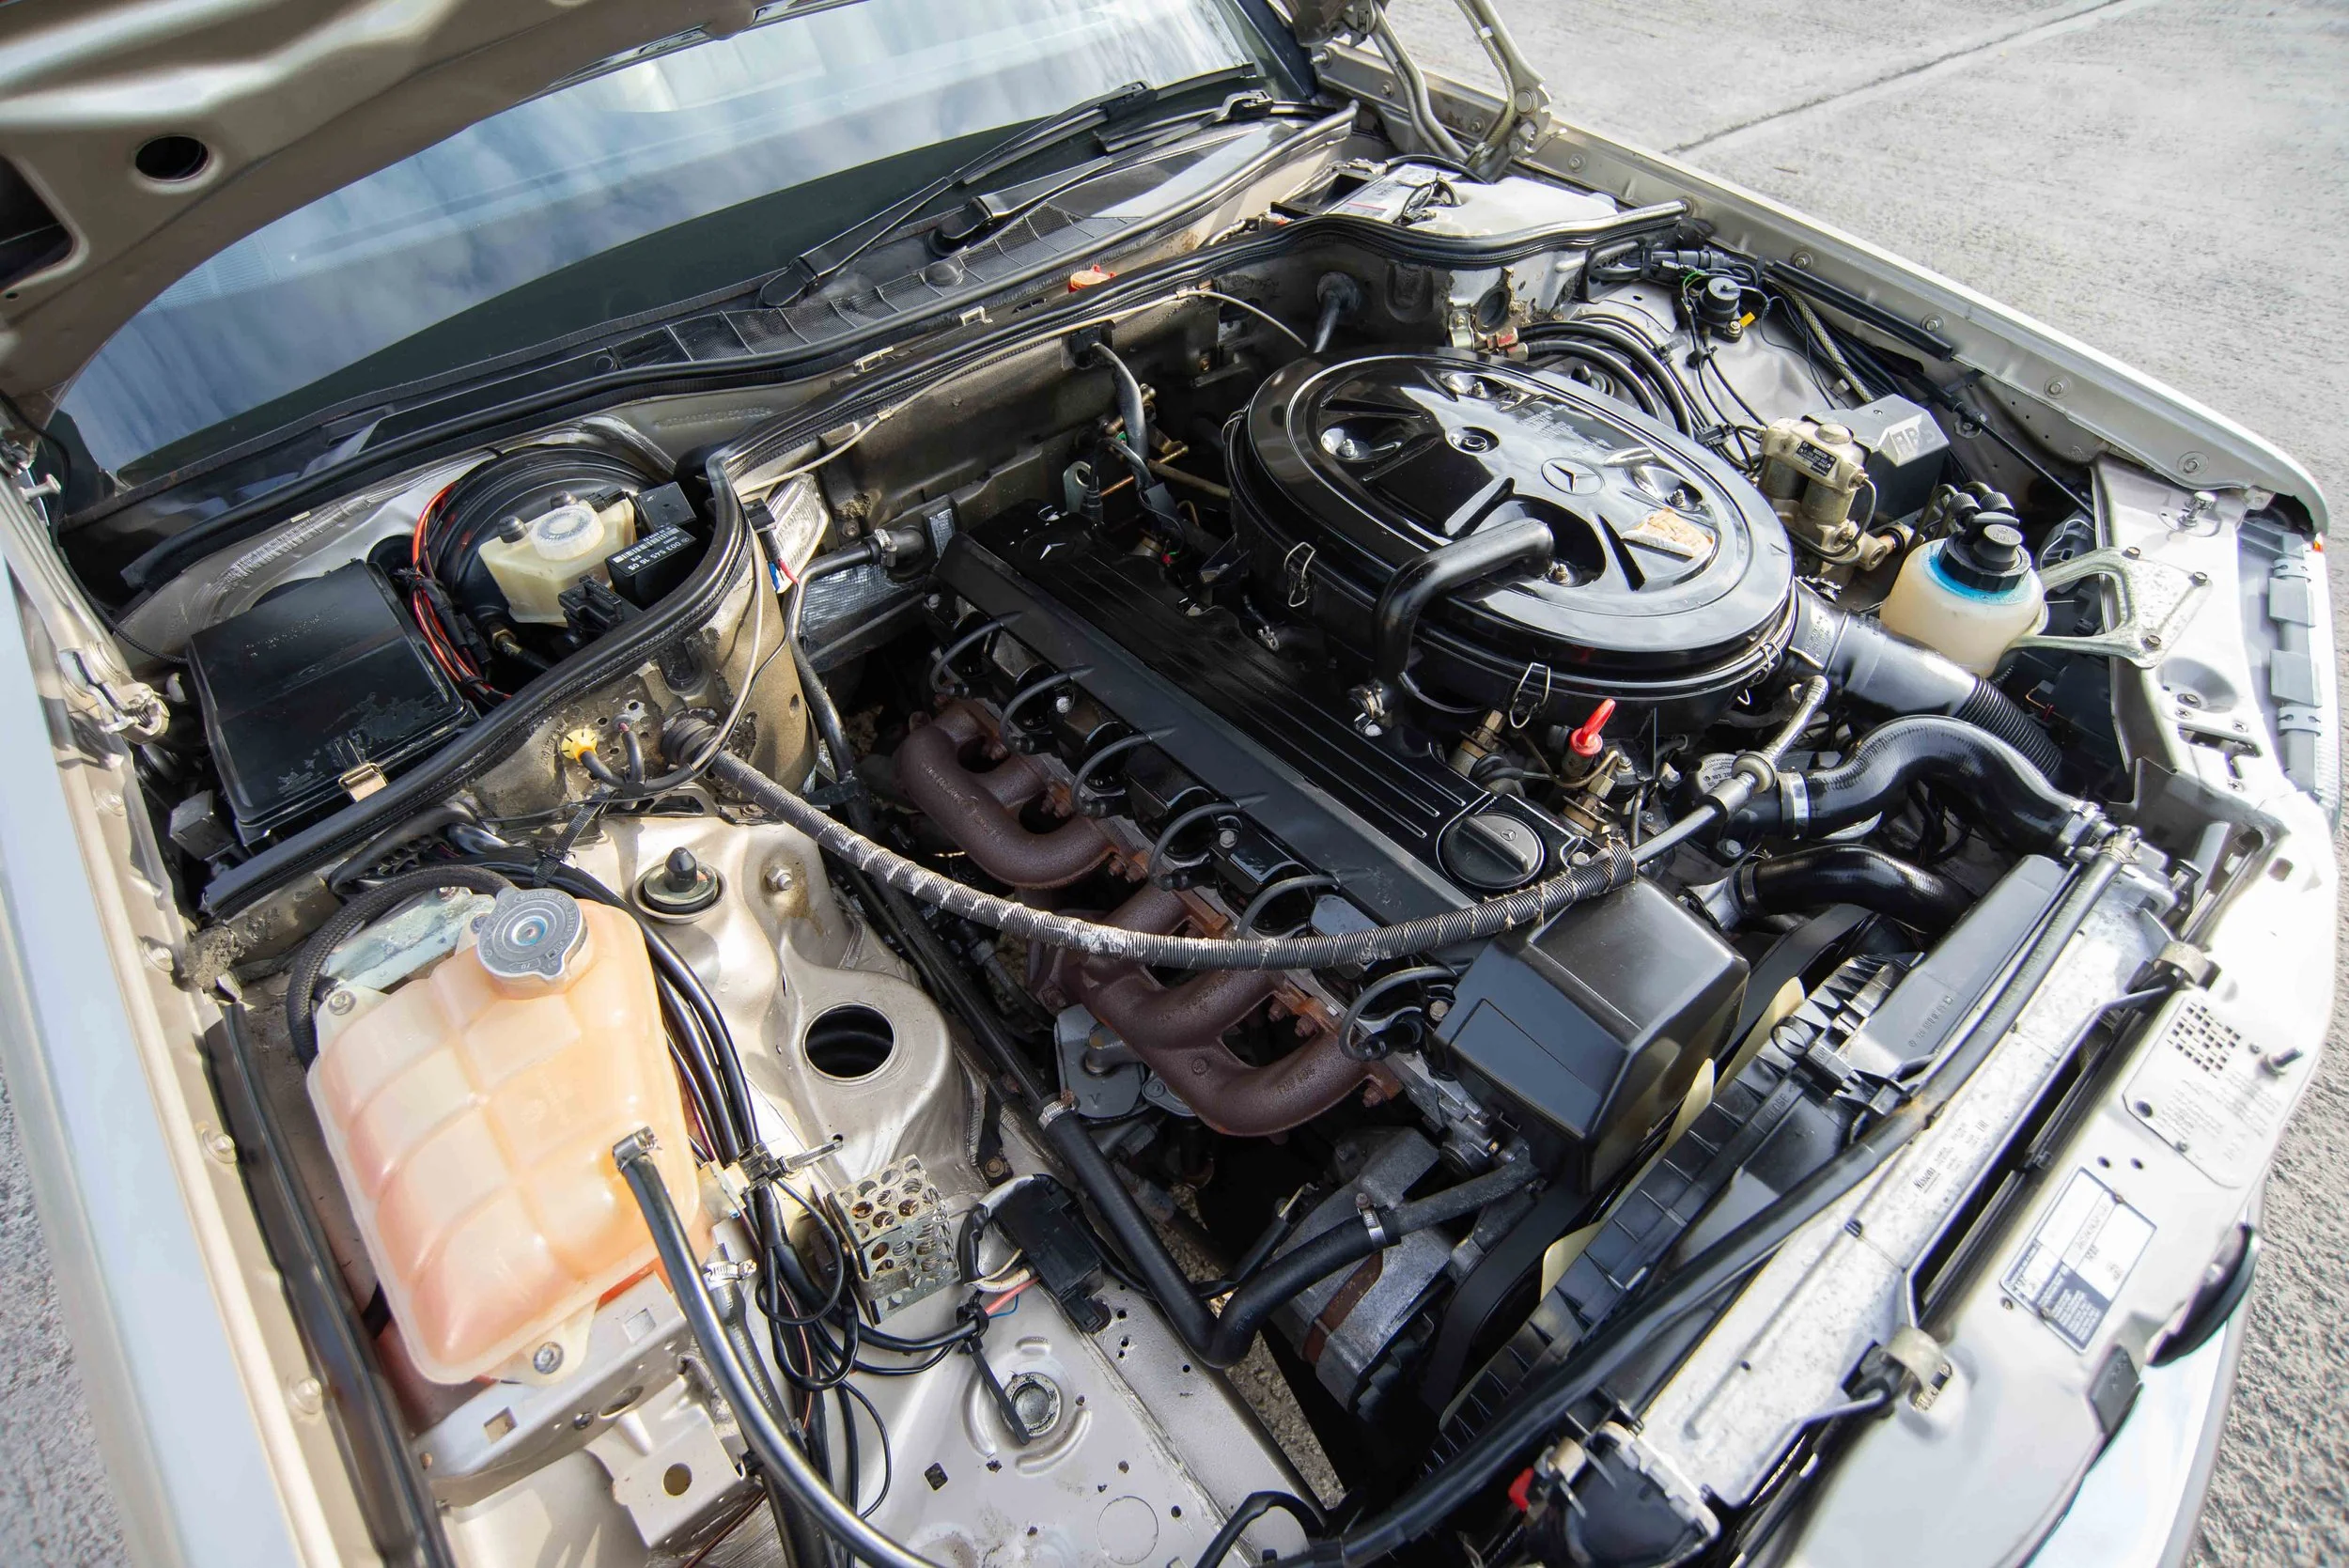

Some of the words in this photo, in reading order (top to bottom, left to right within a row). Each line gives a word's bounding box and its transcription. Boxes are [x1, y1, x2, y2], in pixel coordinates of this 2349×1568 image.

[665, 541, 682, 551] 003
[650, 550, 667, 559] 545
[628, 563, 640, 571] 05
[1912, 1166, 1937, 1191] Nissens
